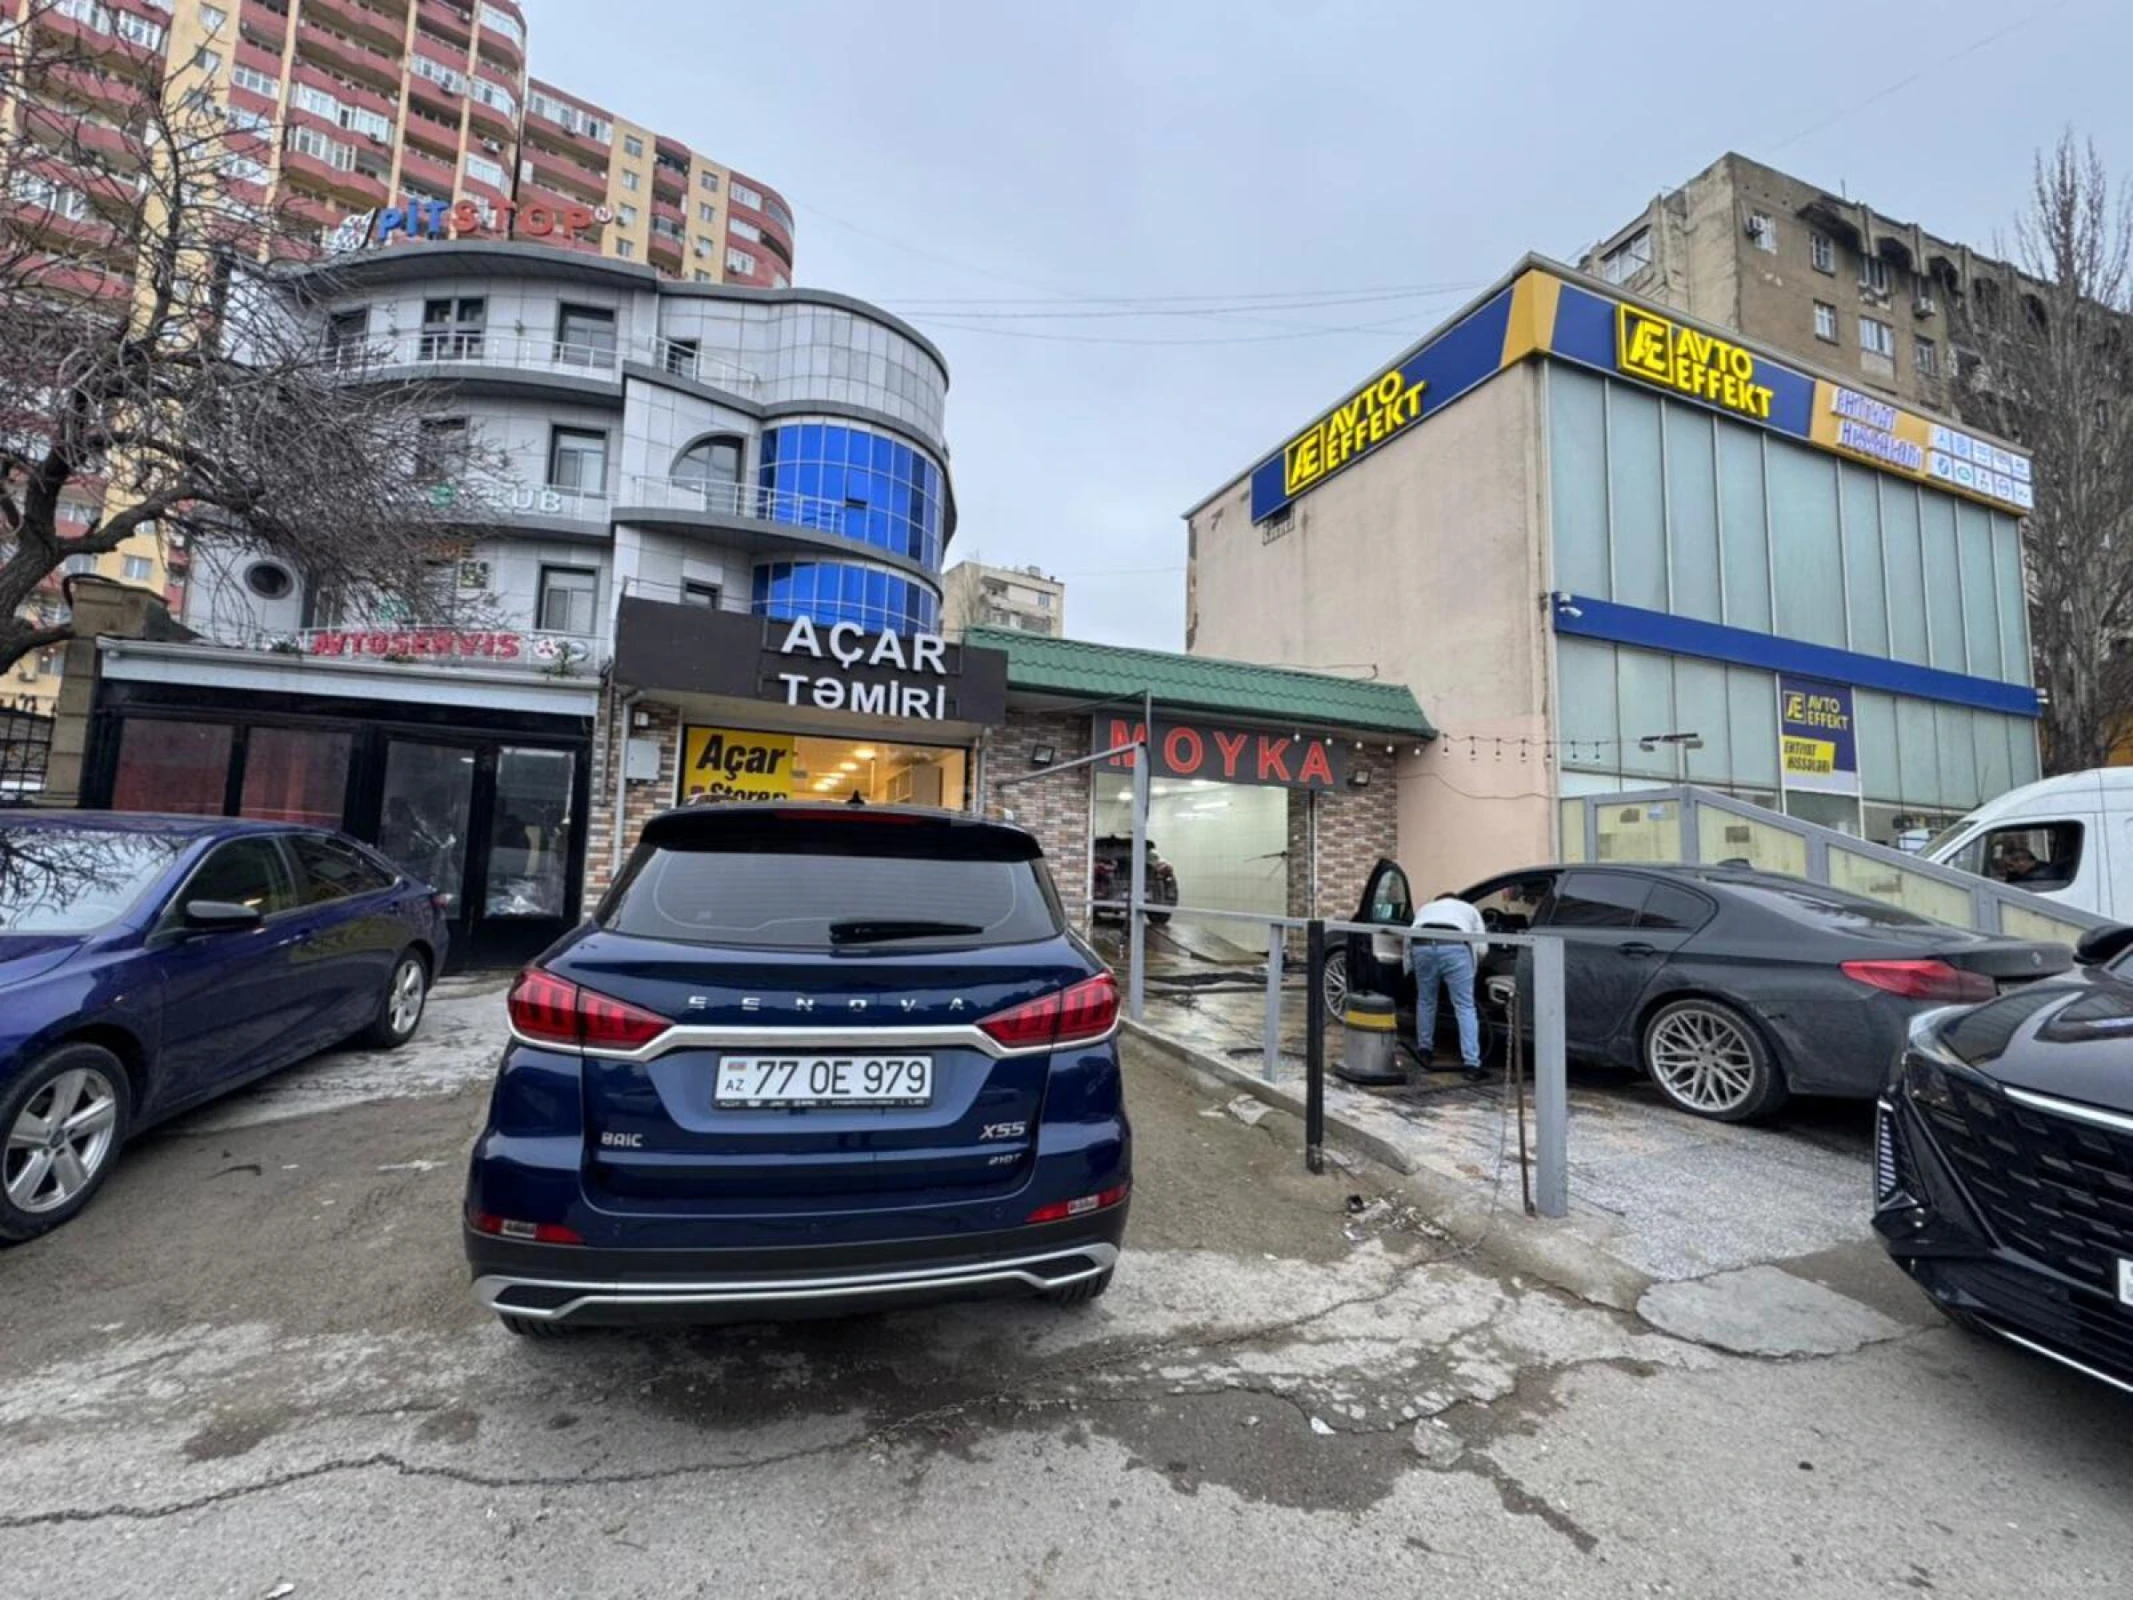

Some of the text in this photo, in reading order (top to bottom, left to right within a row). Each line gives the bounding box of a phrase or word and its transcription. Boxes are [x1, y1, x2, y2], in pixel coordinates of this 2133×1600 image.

[1676, 327, 1753, 381] AVTO
[1327, 370, 1405, 441] AVTO
[1676, 356, 1774, 418] EFFEKT
[1327, 380, 1427, 469] EFFEKT
[780, 615, 947, 675] AÇAR
[778, 673, 947, 720] TƏMİRİ
[1808, 695, 1841, 713] AVTO
[1808, 710, 1849, 731] EFFEKT
[695, 733, 788, 781] Açar
[1110, 719, 1334, 785] MOYKA
[688, 995, 965, 1012] SENOVA
[725, 1079, 744, 1092] AZ
[754, 1060, 799, 1095] 77
[863, 1060, 926, 1095] 979
[601, 1131, 643, 1148] BAIC
[979, 1121, 1027, 1140] X55
